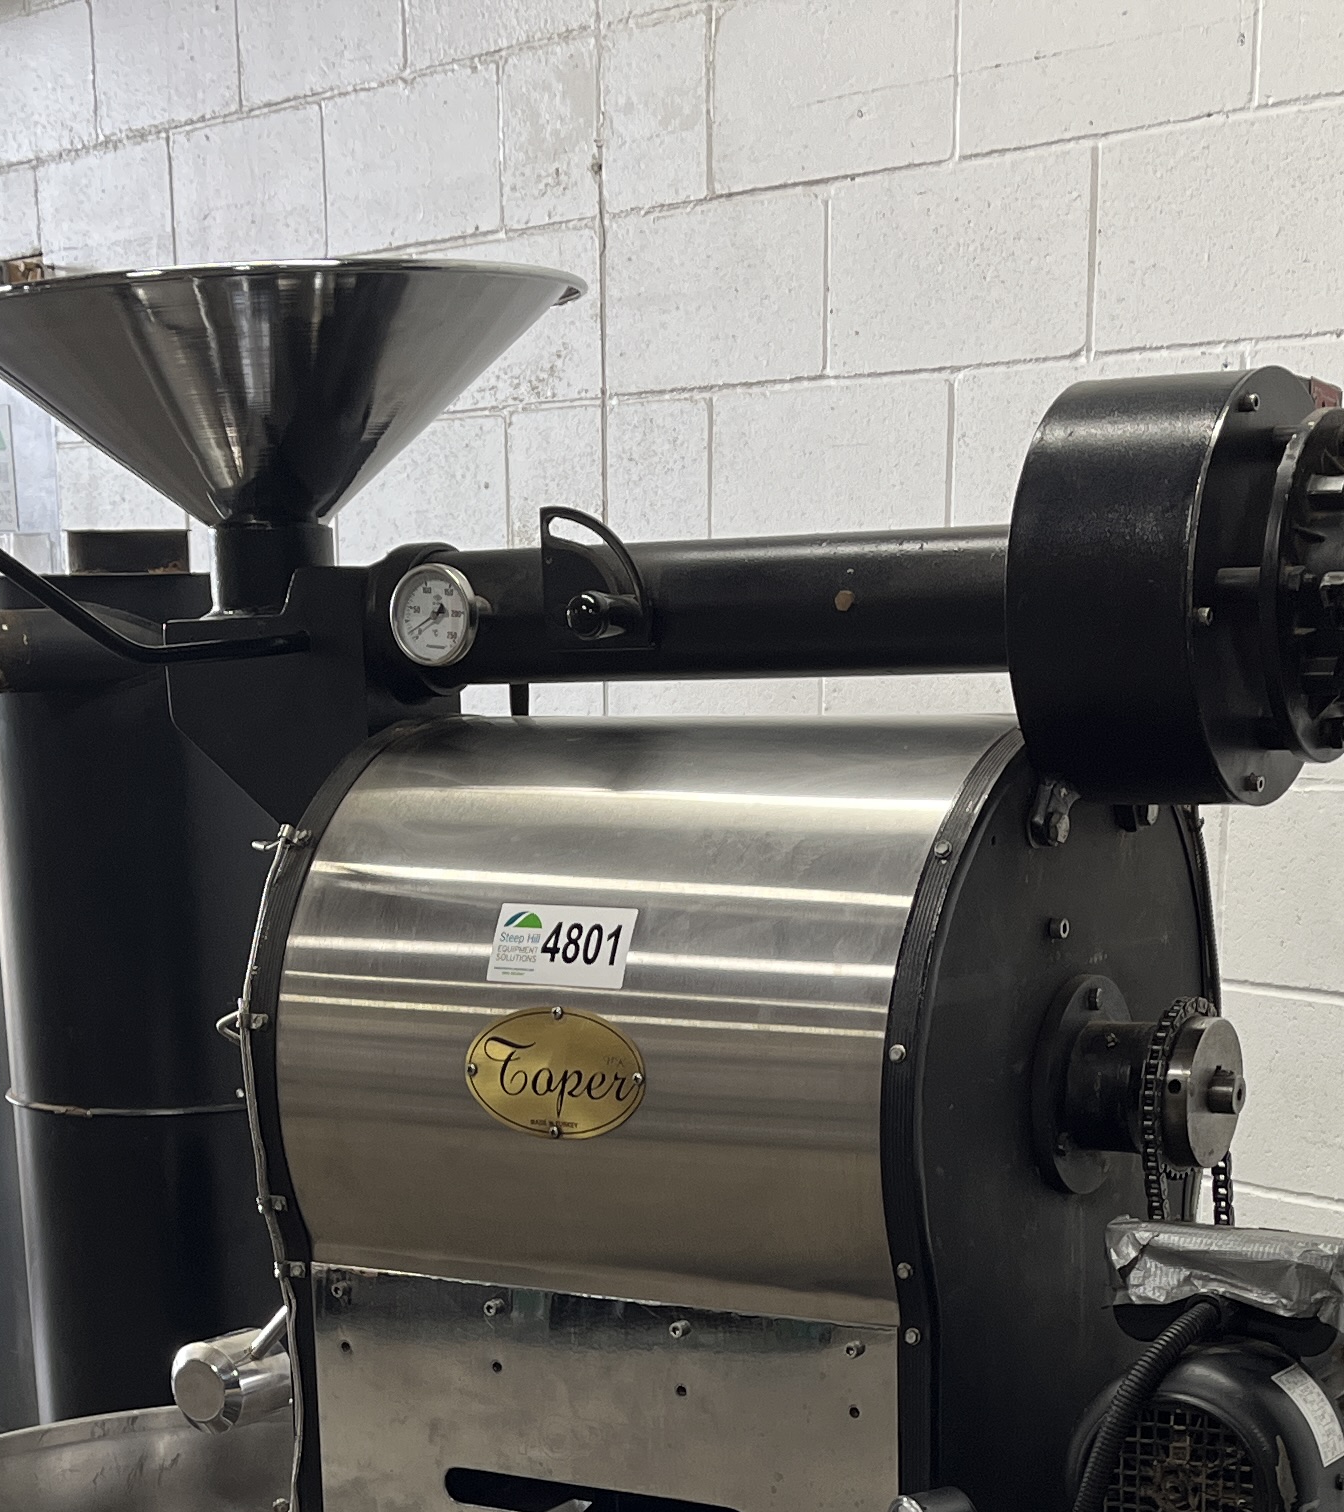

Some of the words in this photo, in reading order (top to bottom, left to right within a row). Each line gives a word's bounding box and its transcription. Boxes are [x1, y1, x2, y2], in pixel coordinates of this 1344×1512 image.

[499, 932, 524, 944] Steep
[527, 933, 541, 944] Hill
[540, 921, 623, 966] 4801
[497, 944, 538, 954] EQUIPMENT
[496, 953, 537, 963] SOLUTIONS
[484, 1036, 635, 1118] Toper
